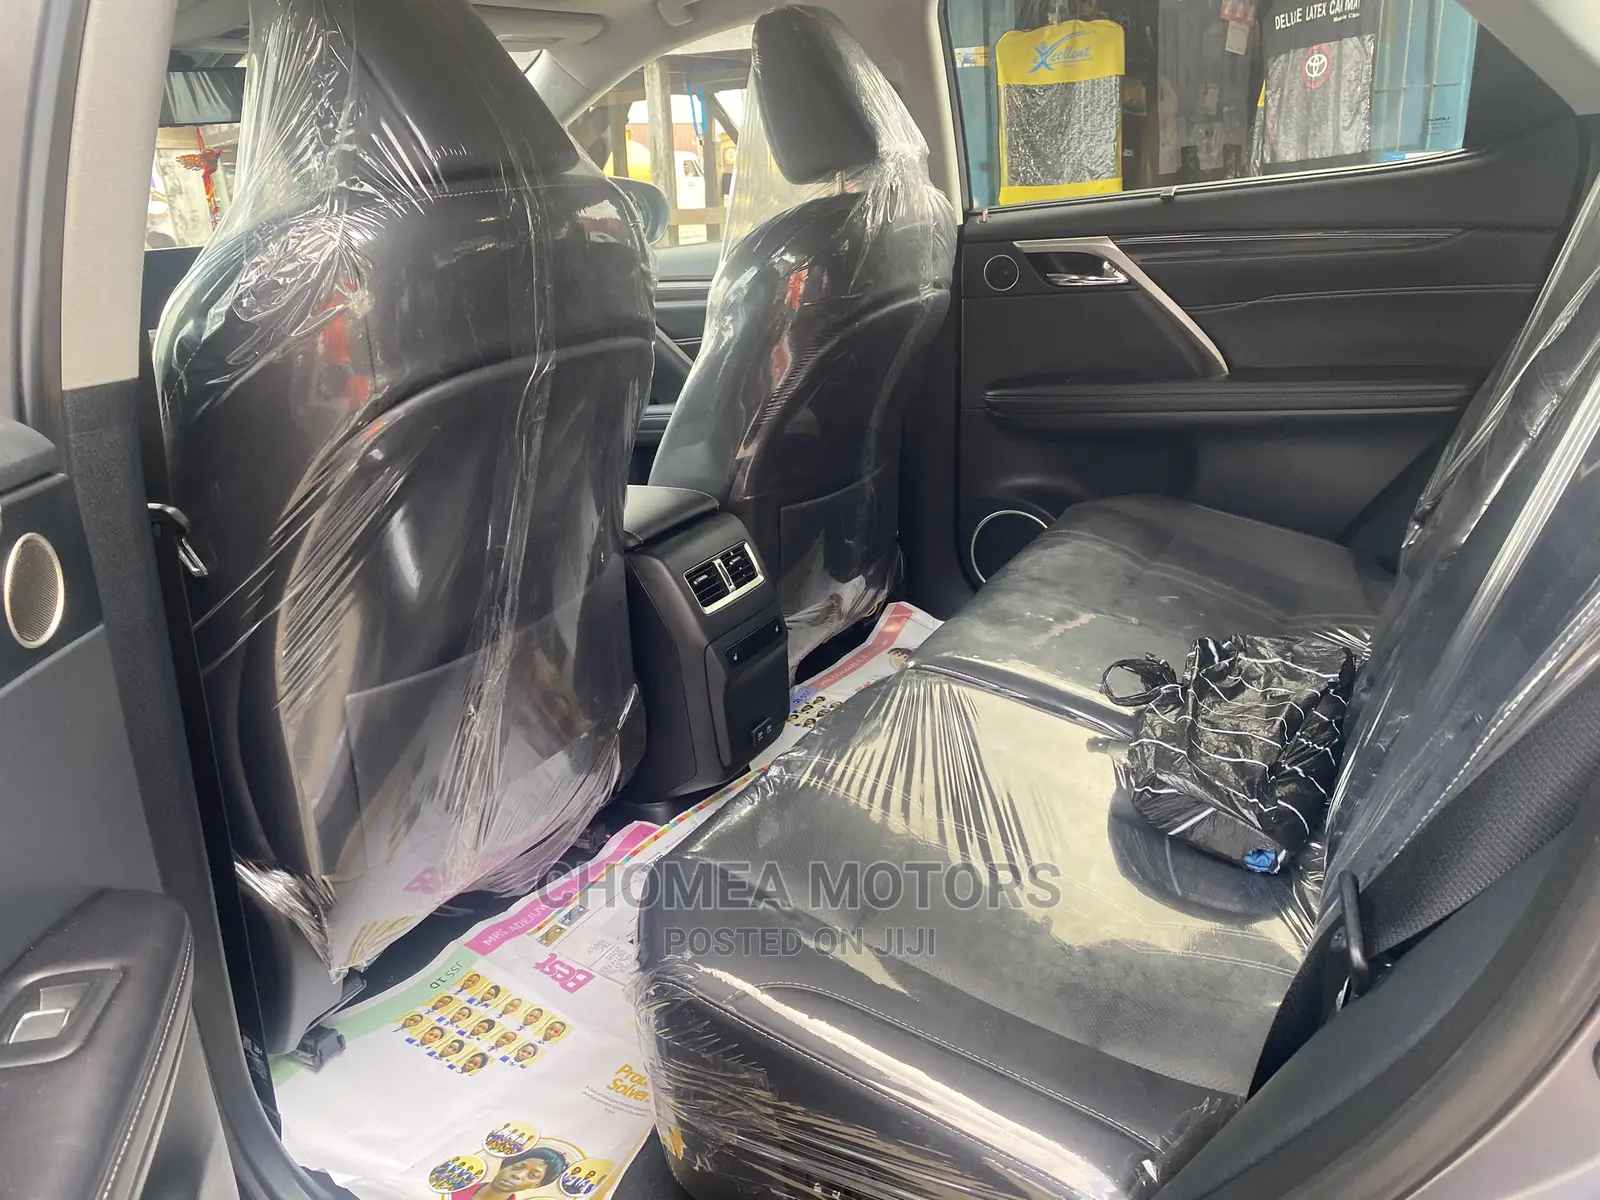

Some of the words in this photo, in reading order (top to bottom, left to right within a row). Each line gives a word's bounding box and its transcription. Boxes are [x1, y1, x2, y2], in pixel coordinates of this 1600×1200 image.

[1305, 3, 1327, 21] LATEX
[483, 928, 509, 947] MRS
[446, 961, 464, 978] JSS
[533, 952, 596, 993] Best
